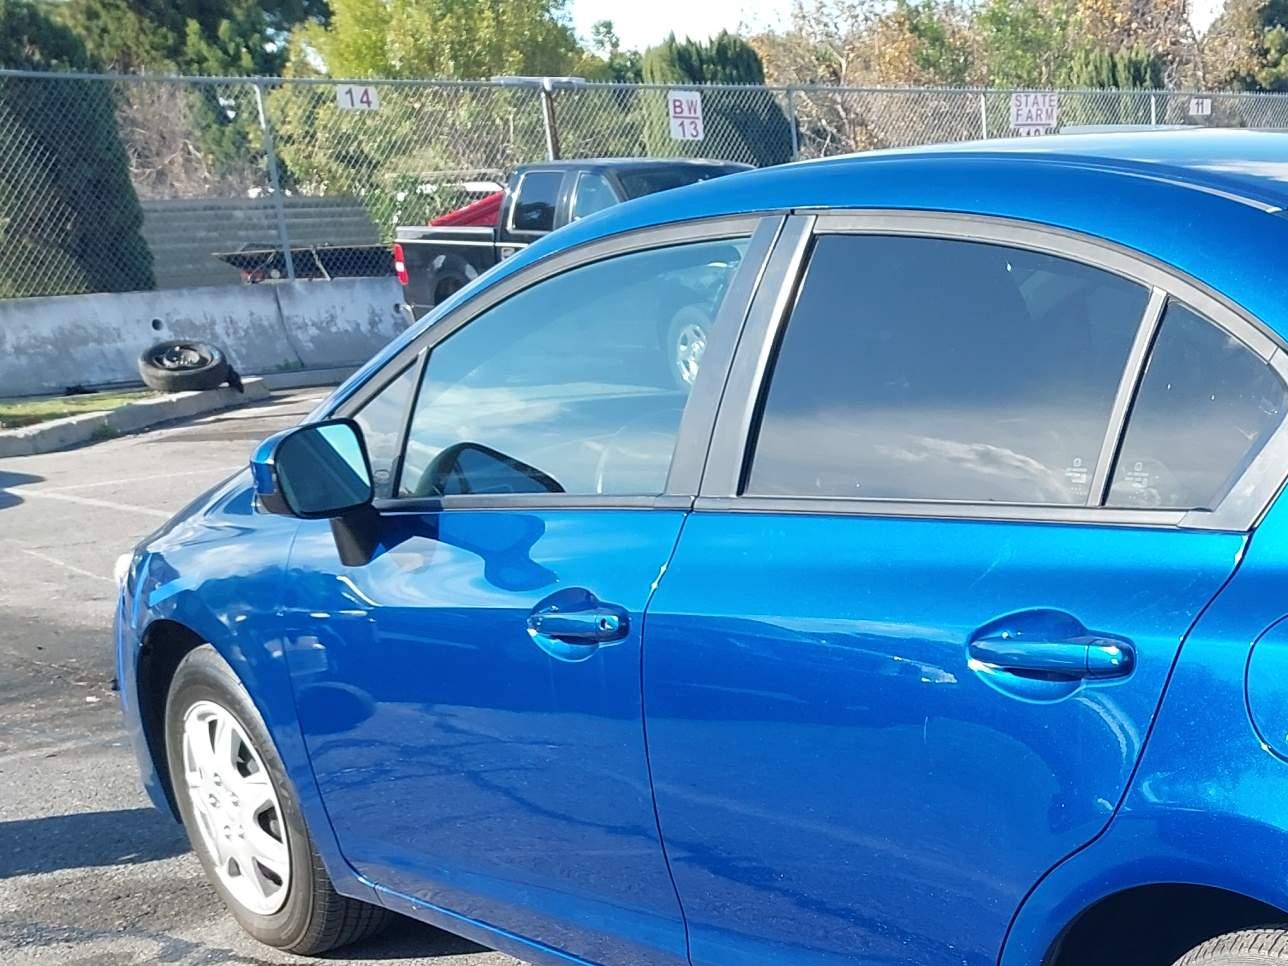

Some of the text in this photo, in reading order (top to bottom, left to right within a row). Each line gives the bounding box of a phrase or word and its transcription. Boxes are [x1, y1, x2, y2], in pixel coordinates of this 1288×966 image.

[344, 87, 372, 107] 14
[1015, 94, 1056, 108] STATE
[1195, 100, 1204, 113] 11
[1016, 108, 1054, 122] FARM
[678, 120, 699, 138] 13
